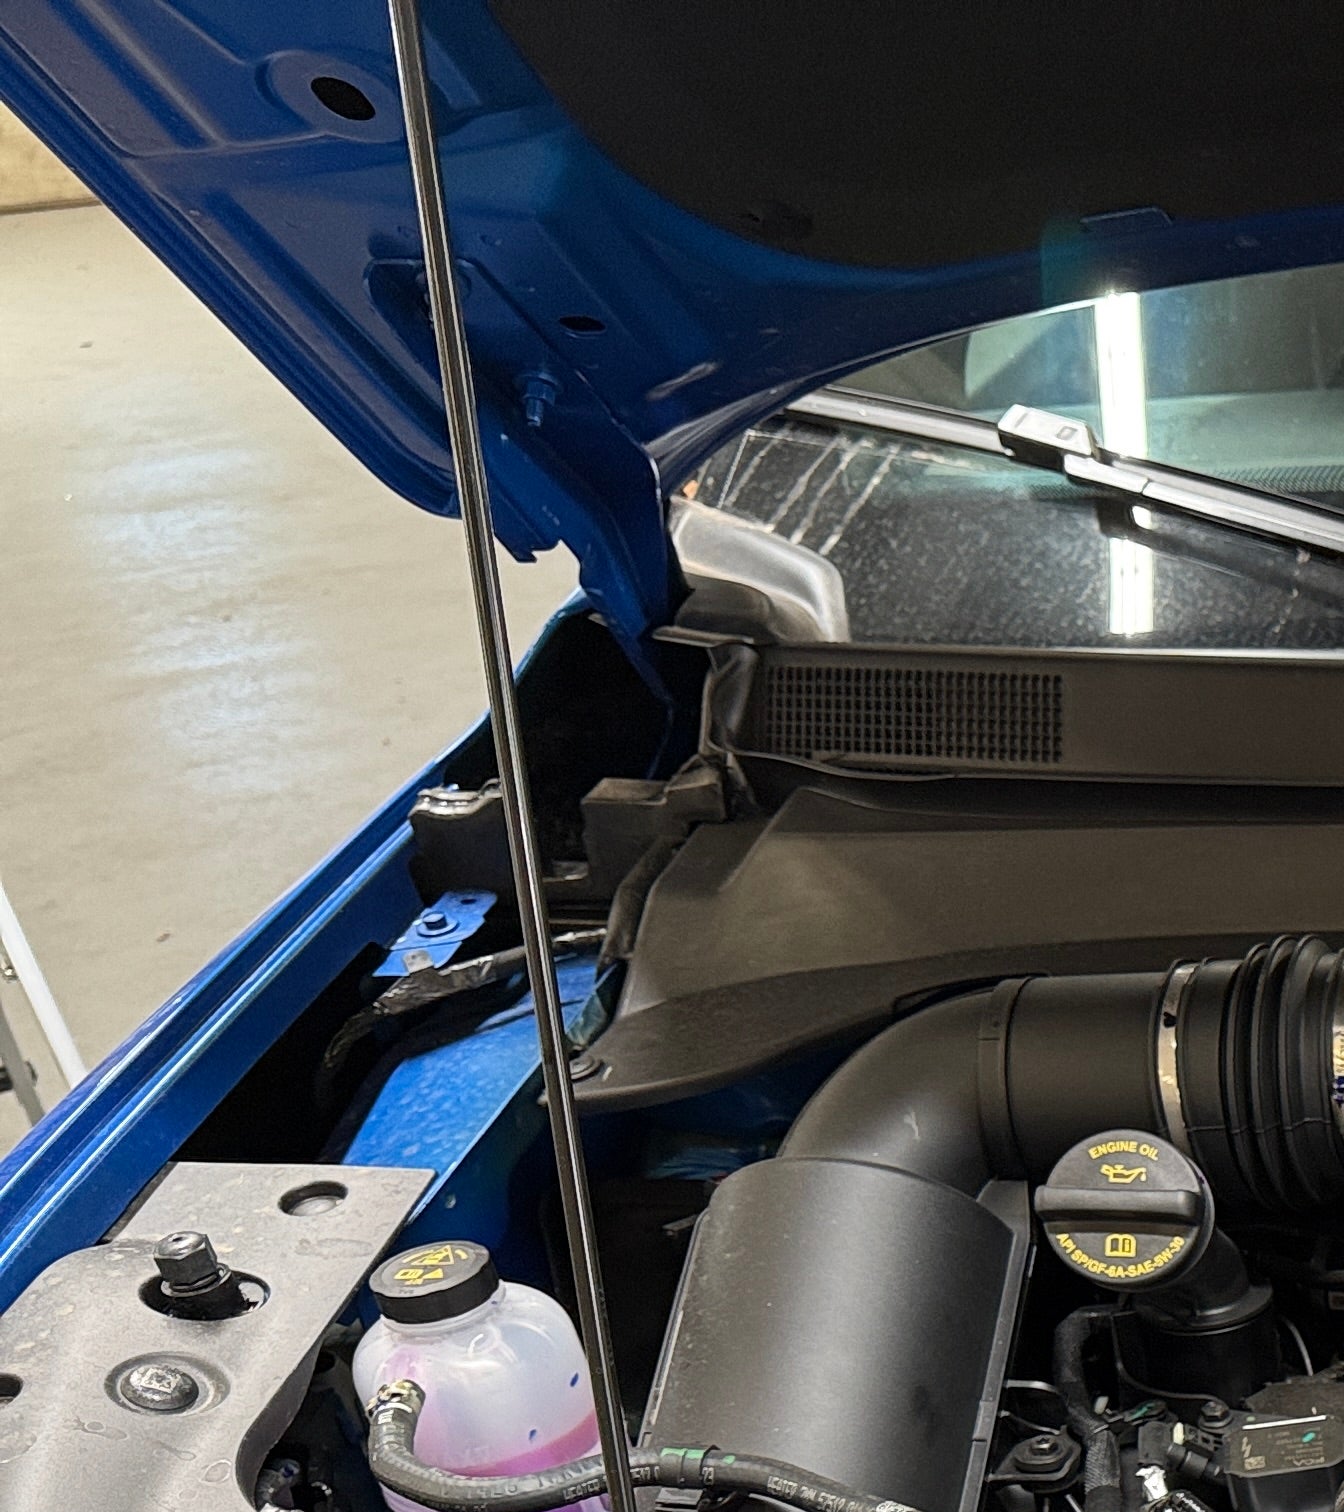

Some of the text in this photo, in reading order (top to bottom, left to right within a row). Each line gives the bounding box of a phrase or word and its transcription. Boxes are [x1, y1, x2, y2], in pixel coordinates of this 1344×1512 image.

[1088, 1140, 1159, 1161] ENGINE OIL
[1056, 1233, 1077, 1254] API
